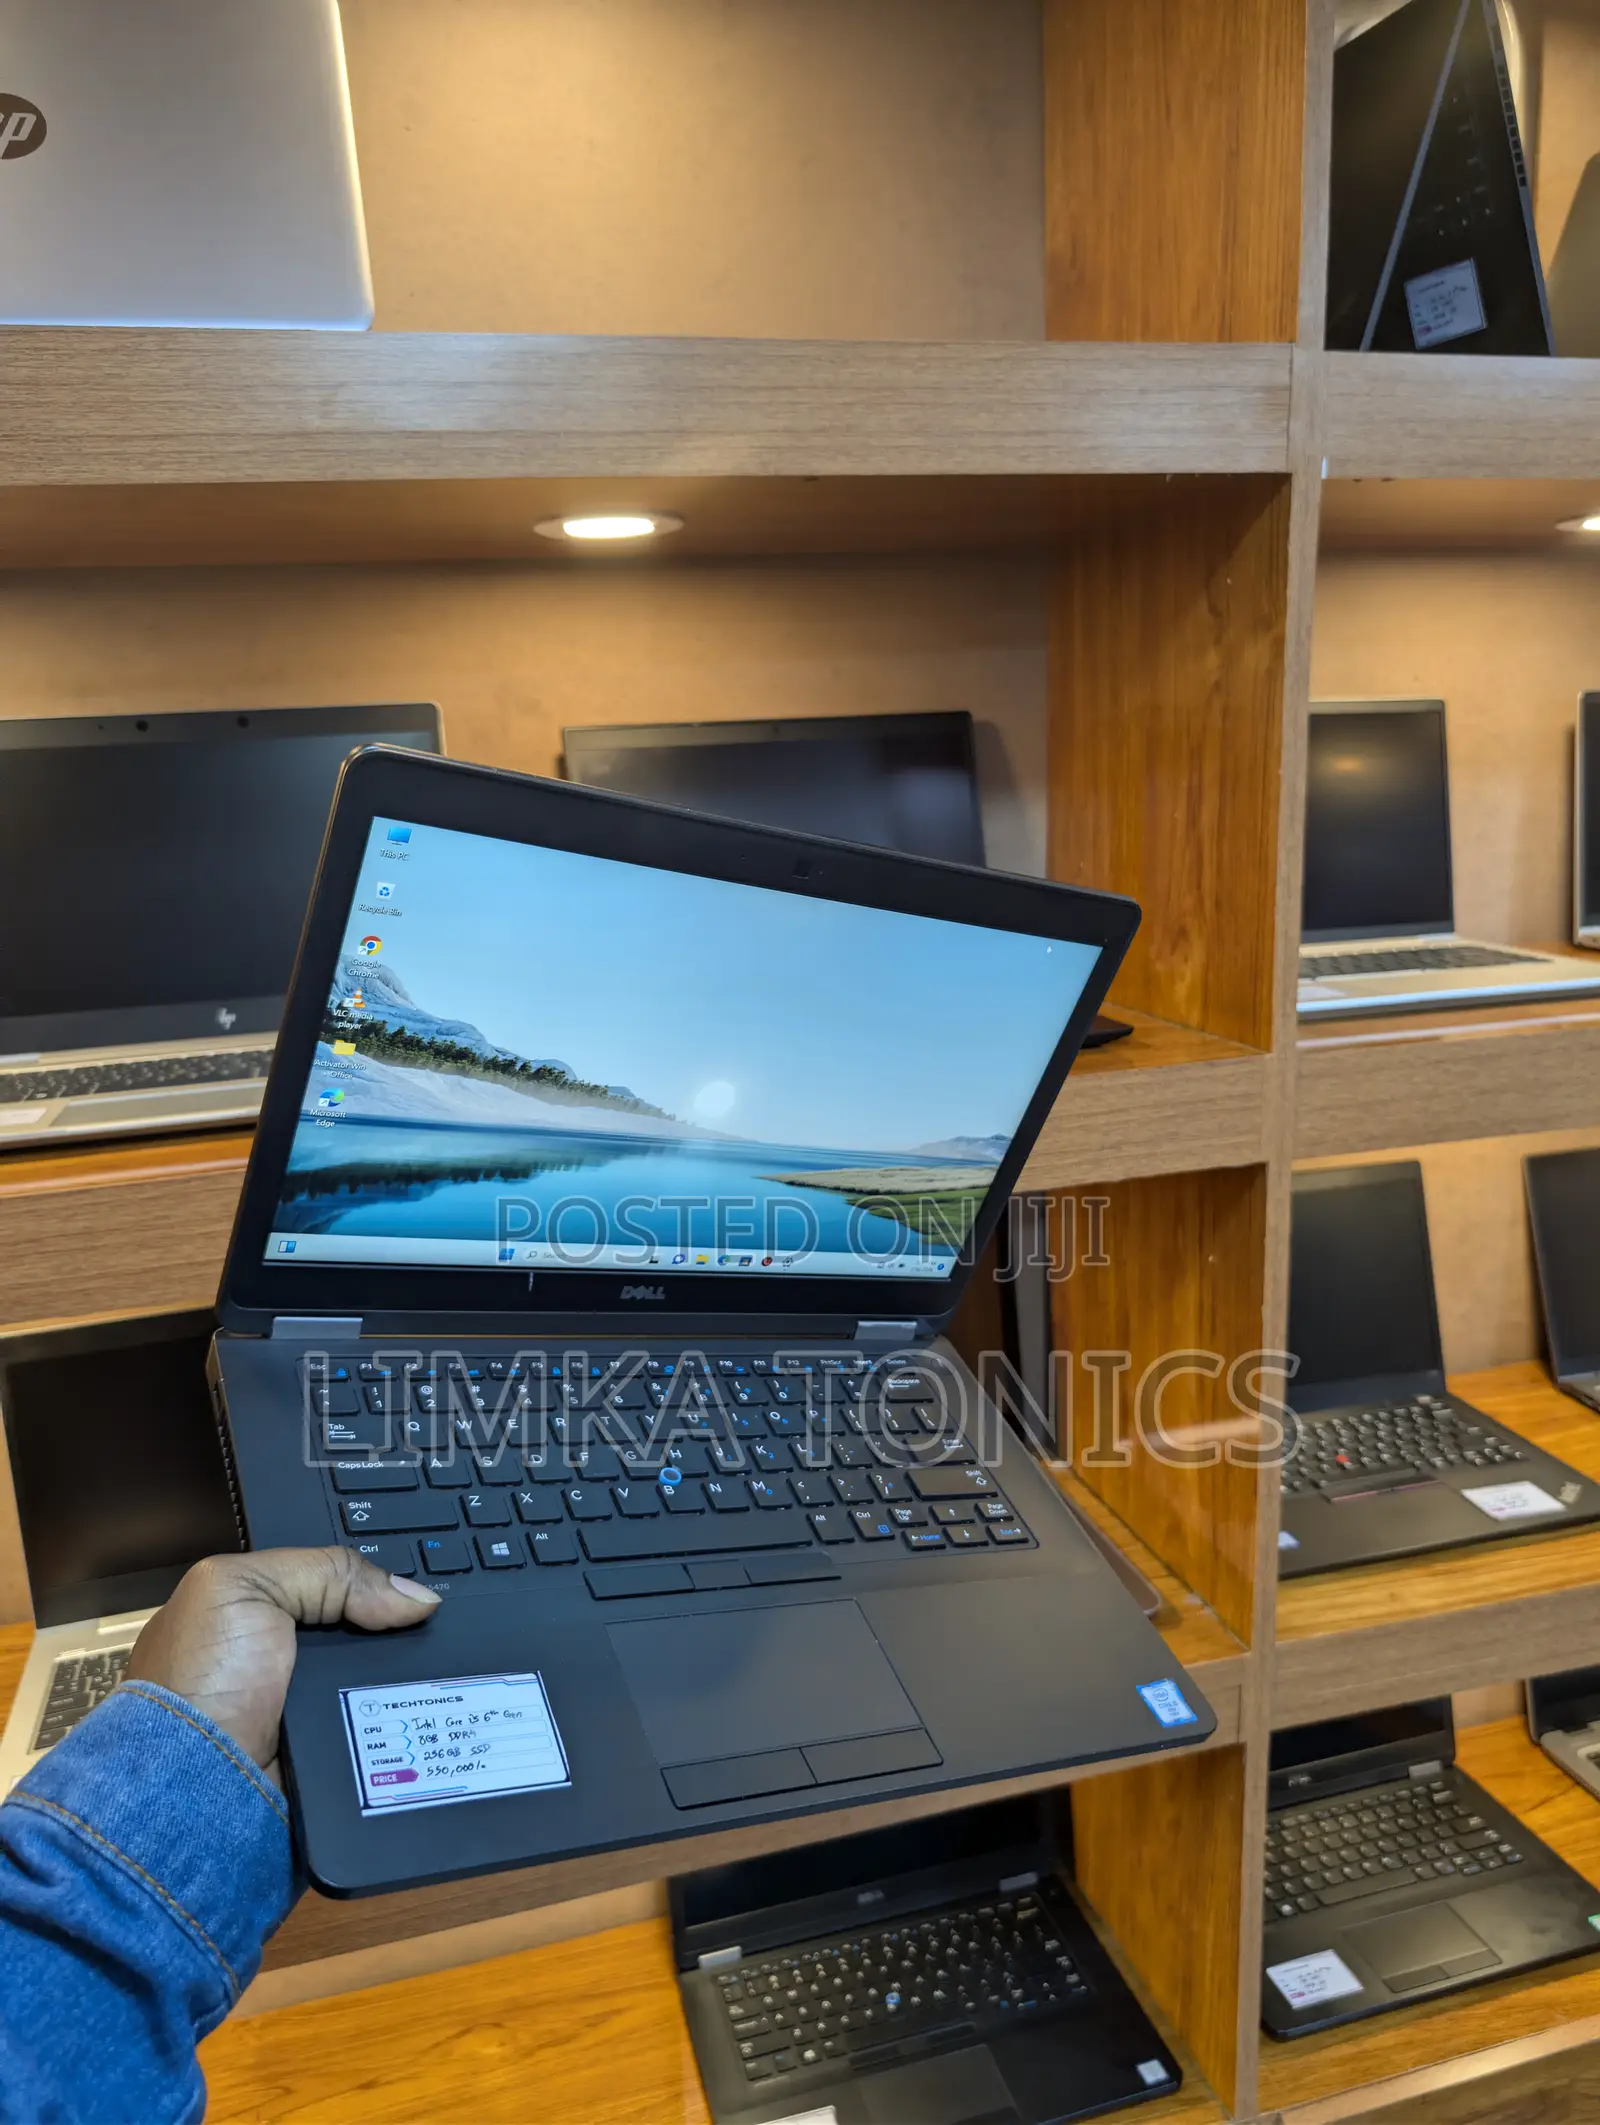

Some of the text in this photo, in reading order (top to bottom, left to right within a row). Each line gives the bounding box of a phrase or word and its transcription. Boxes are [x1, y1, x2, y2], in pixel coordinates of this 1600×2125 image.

[0, 112, 37, 159] p
[380, 849, 409, 861] This PC
[358, 904, 402, 917] Recycle Bin
[351, 958, 382, 969] Google
[347, 968, 380, 980] Chrome
[332, 1009, 373, 1020] VLC media
[337, 1021, 362, 1030] player
[313, 1059, 367, 1071] Activator Win
[330, 1071, 353, 1080] Office
[309, 1108, 346, 1118] Microsoft
[316, 1119, 335, 1128] Edge
[620, 1285, 666, 1300] DELL
[408, 1421, 420, 1431] Q
[456, 1420, 472, 1430] W
[508, 1419, 518, 1428] E
[555, 1417, 566, 1427] R
[601, 1416, 610, 1425] T
[687, 1414, 699, 1423] U
[338, 1462, 361, 1470] Caps
[431, 1458, 442, 1468] A
[482, 1456, 493, 1466] S
[530, 1455, 543, 1464] D
[580, 1452, 589, 1461] F
[625, 1451, 637, 1460] G
[670, 1449, 682, 1458] H
[756, 1445, 767, 1454] K
[348, 1501, 372, 1509] Shift
[469, 1495, 482, 1506] Z
[520, 1493, 533, 1503] X
[571, 1490, 583, 1500] C
[617, 1488, 629, 1498] V
[664, 1485, 675, 1495] B
[709, 1483, 722, 1492] N
[752, 1481, 766, 1490] M
[359, 1544, 379, 1553] Ctrl
[427, 1540, 441, 1548] Fn
[856, 1511, 871, 1519] Ctrl
[920, 1533, 941, 1541] Home
[382, 1695, 464, 1710] TECHTONICS
[364, 1726, 382, 1735] CPU
[411, 1716, 437, 1731] Intel
[503, 1709, 523, 1720] Gen
[367, 1741, 387, 1750] RAM
[371, 1756, 404, 1766] STORAGE
[470, 1743, 491, 1757] SSD
[373, 1773, 398, 1785] PRICE
